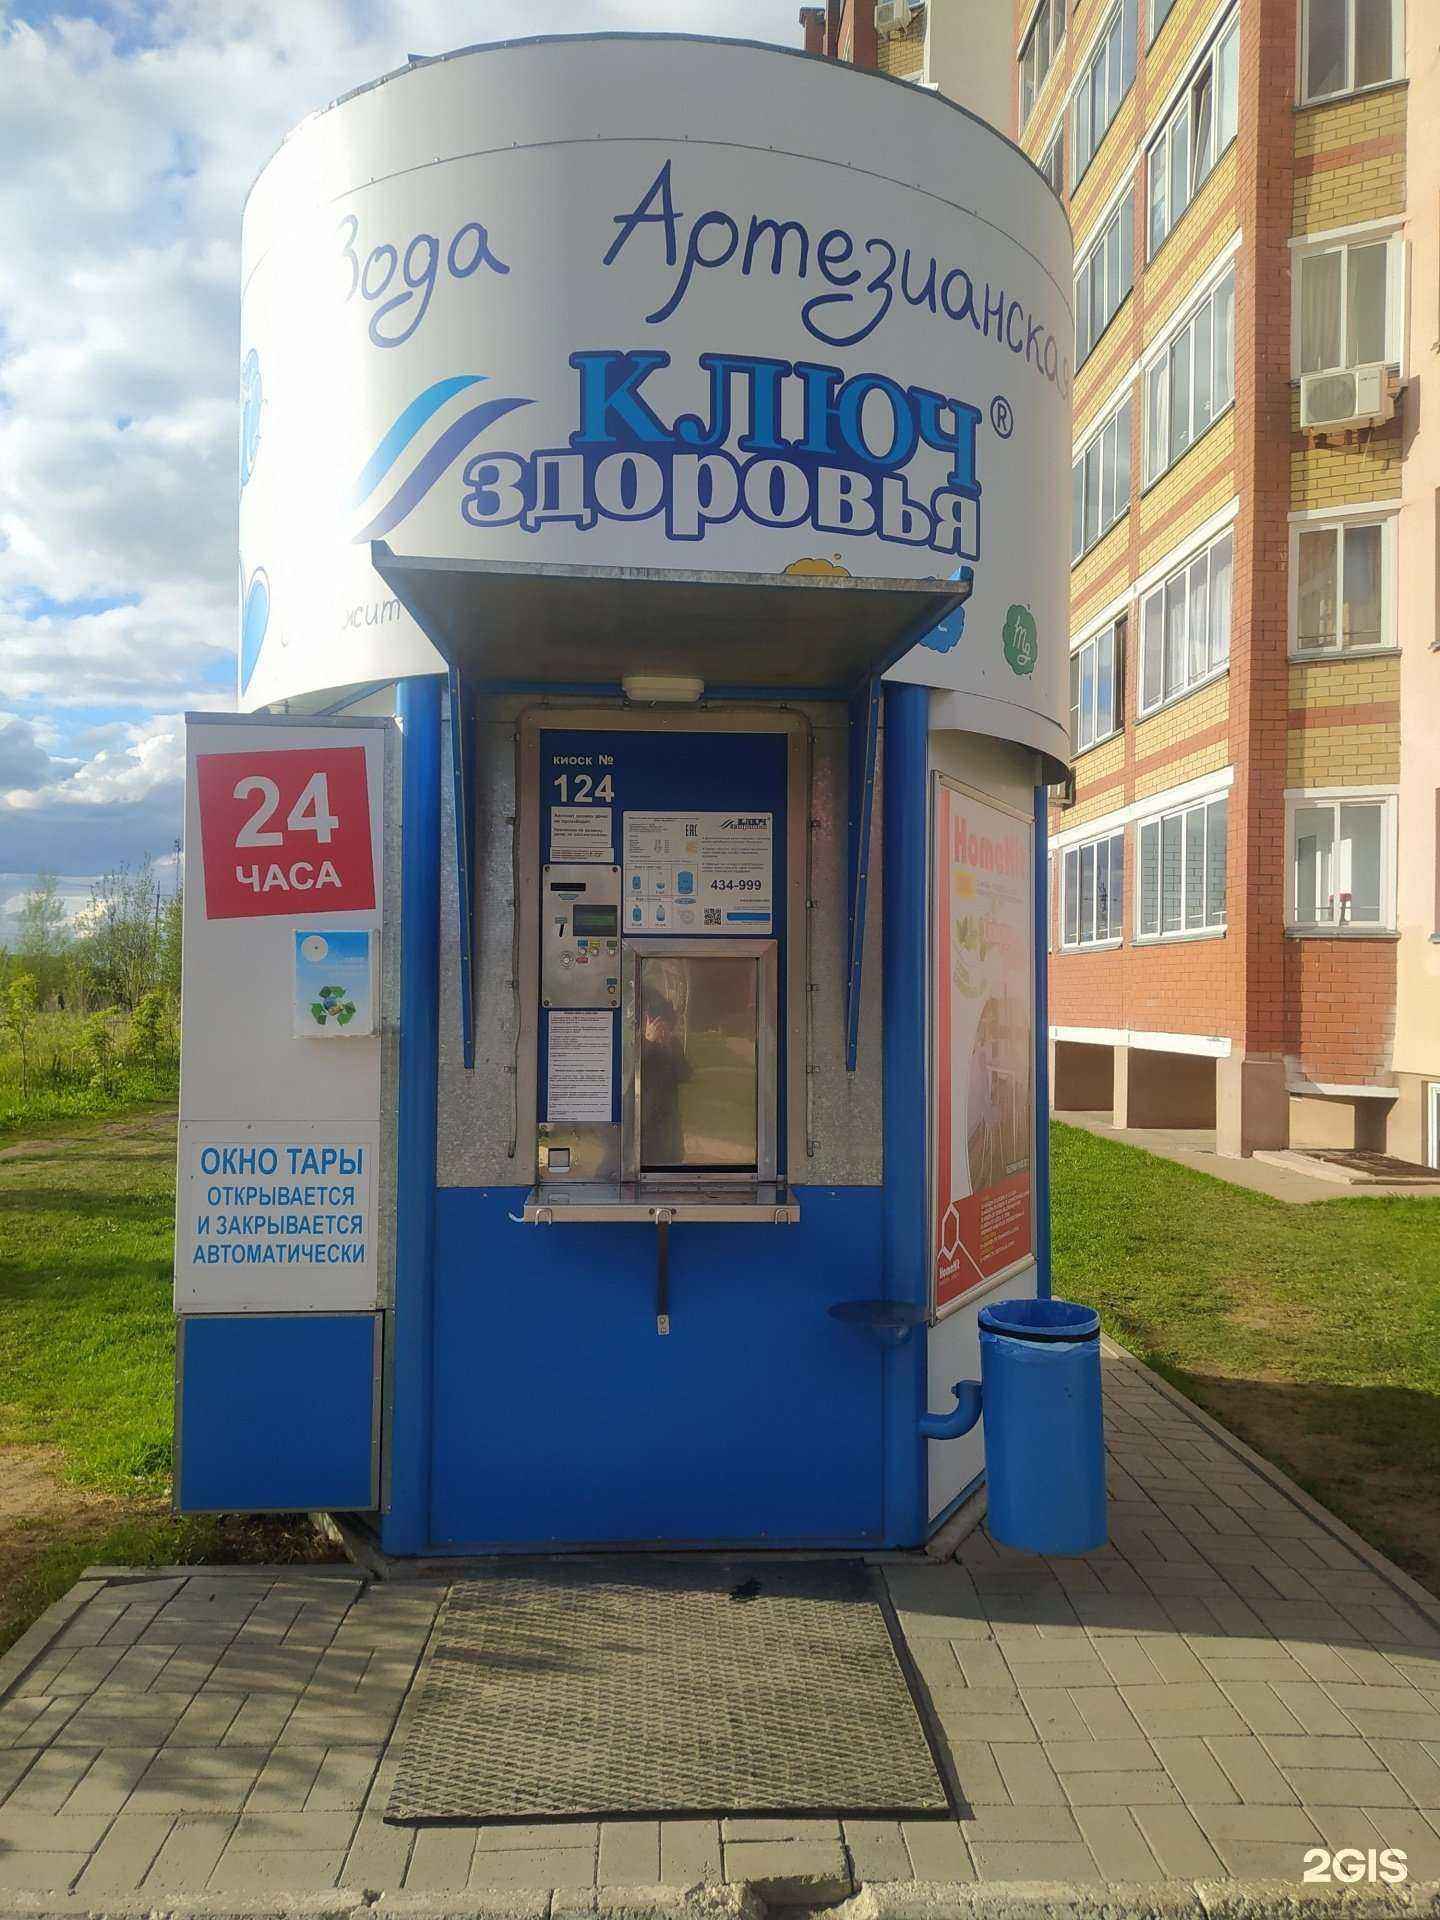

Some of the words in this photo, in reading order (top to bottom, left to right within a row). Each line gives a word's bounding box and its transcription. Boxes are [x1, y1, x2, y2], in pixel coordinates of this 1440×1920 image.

[569, 350, 982, 497] КЛЮЧ
[460, 450, 981, 561] здоровья
[554, 774, 615, 803] 124
[232, 772, 339, 848] 24
[235, 861, 342, 893] ЧАСА
[711, 879, 762, 891] 434-999
[200, 1147, 278, 1175] ОКНО
[285, 1148, 363, 1175] ТАРЫ
[207, 1186, 355, 1206] ОТКРЫВАЕТСЯ
[197, 1215, 210, 1234] И
[216, 1215, 363, 1235] ЗАКРЫВАЕТСЯ
[192, 1244, 365, 1264] АВТОМАТИЧЕСКИ
